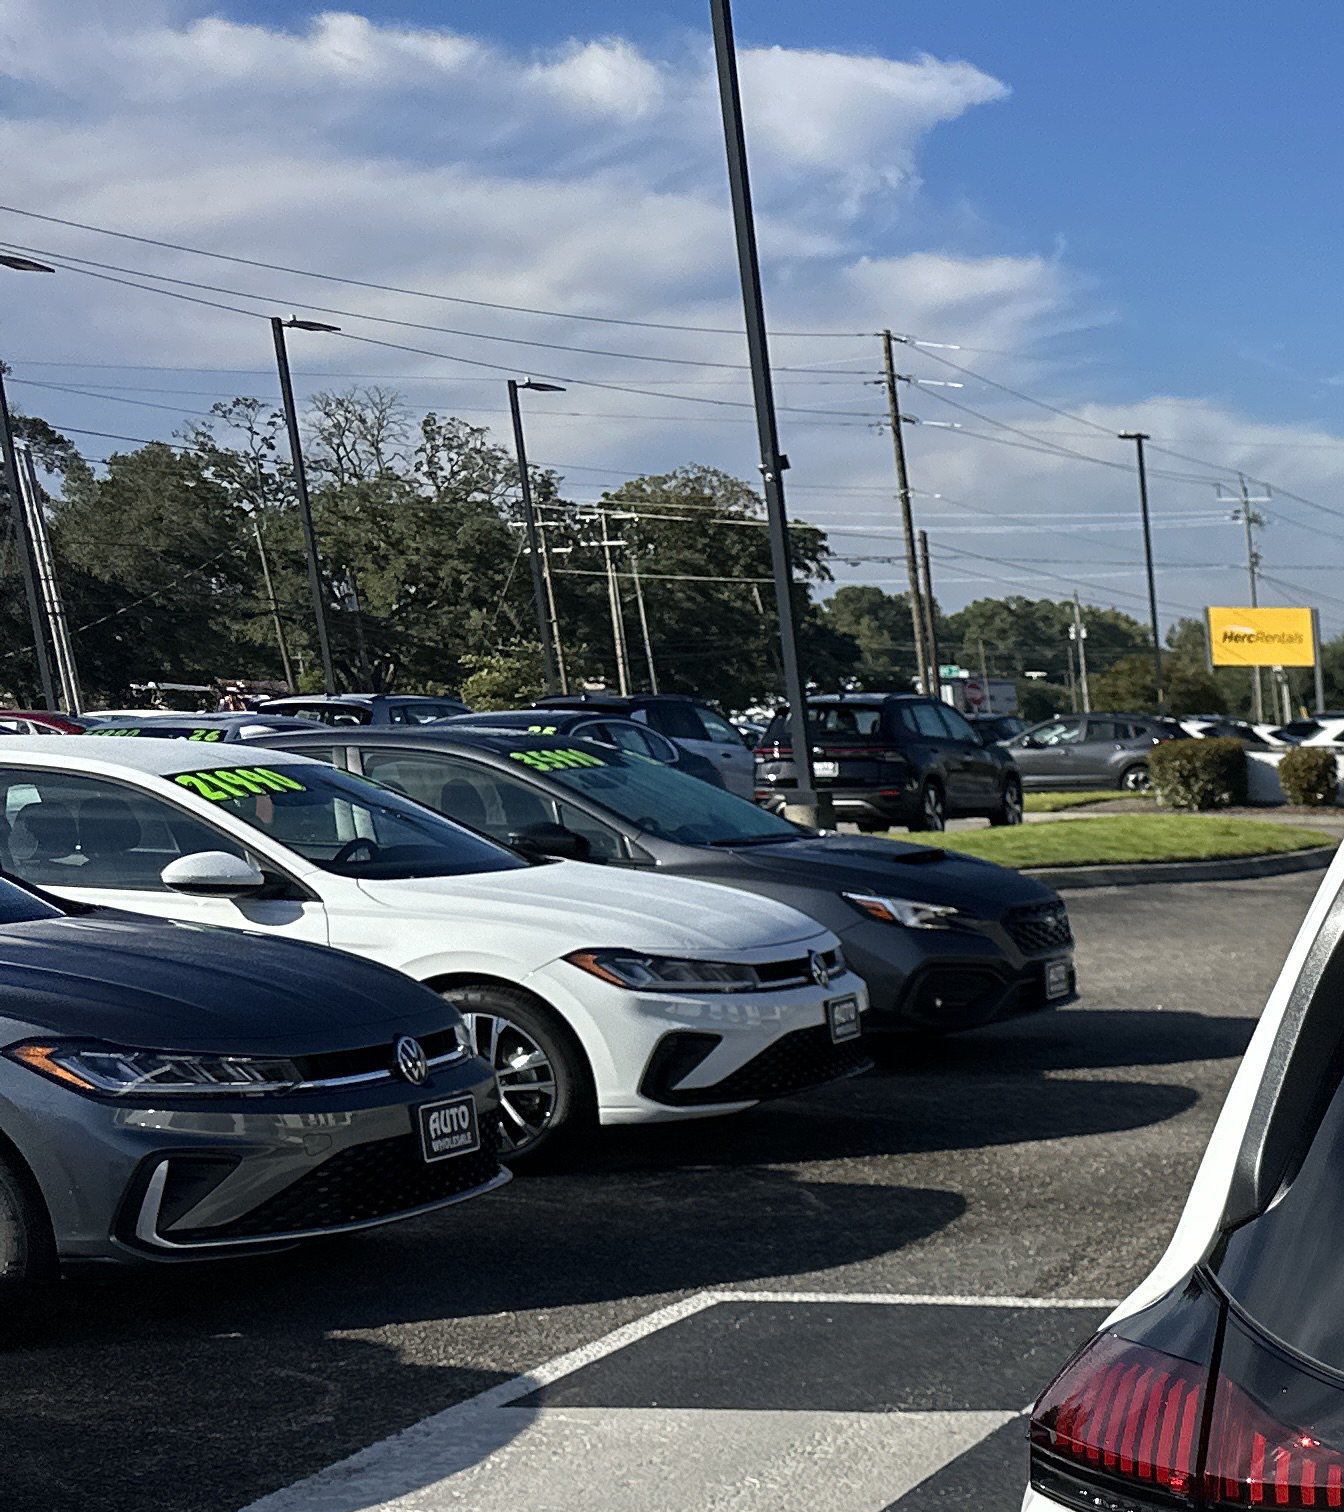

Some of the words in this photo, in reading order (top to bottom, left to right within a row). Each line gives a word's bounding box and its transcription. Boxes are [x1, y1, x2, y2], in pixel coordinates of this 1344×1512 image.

[188, 729, 221, 742] 26
[174, 767, 307, 801] 21990
[429, 1105, 470, 1140] AUTO
